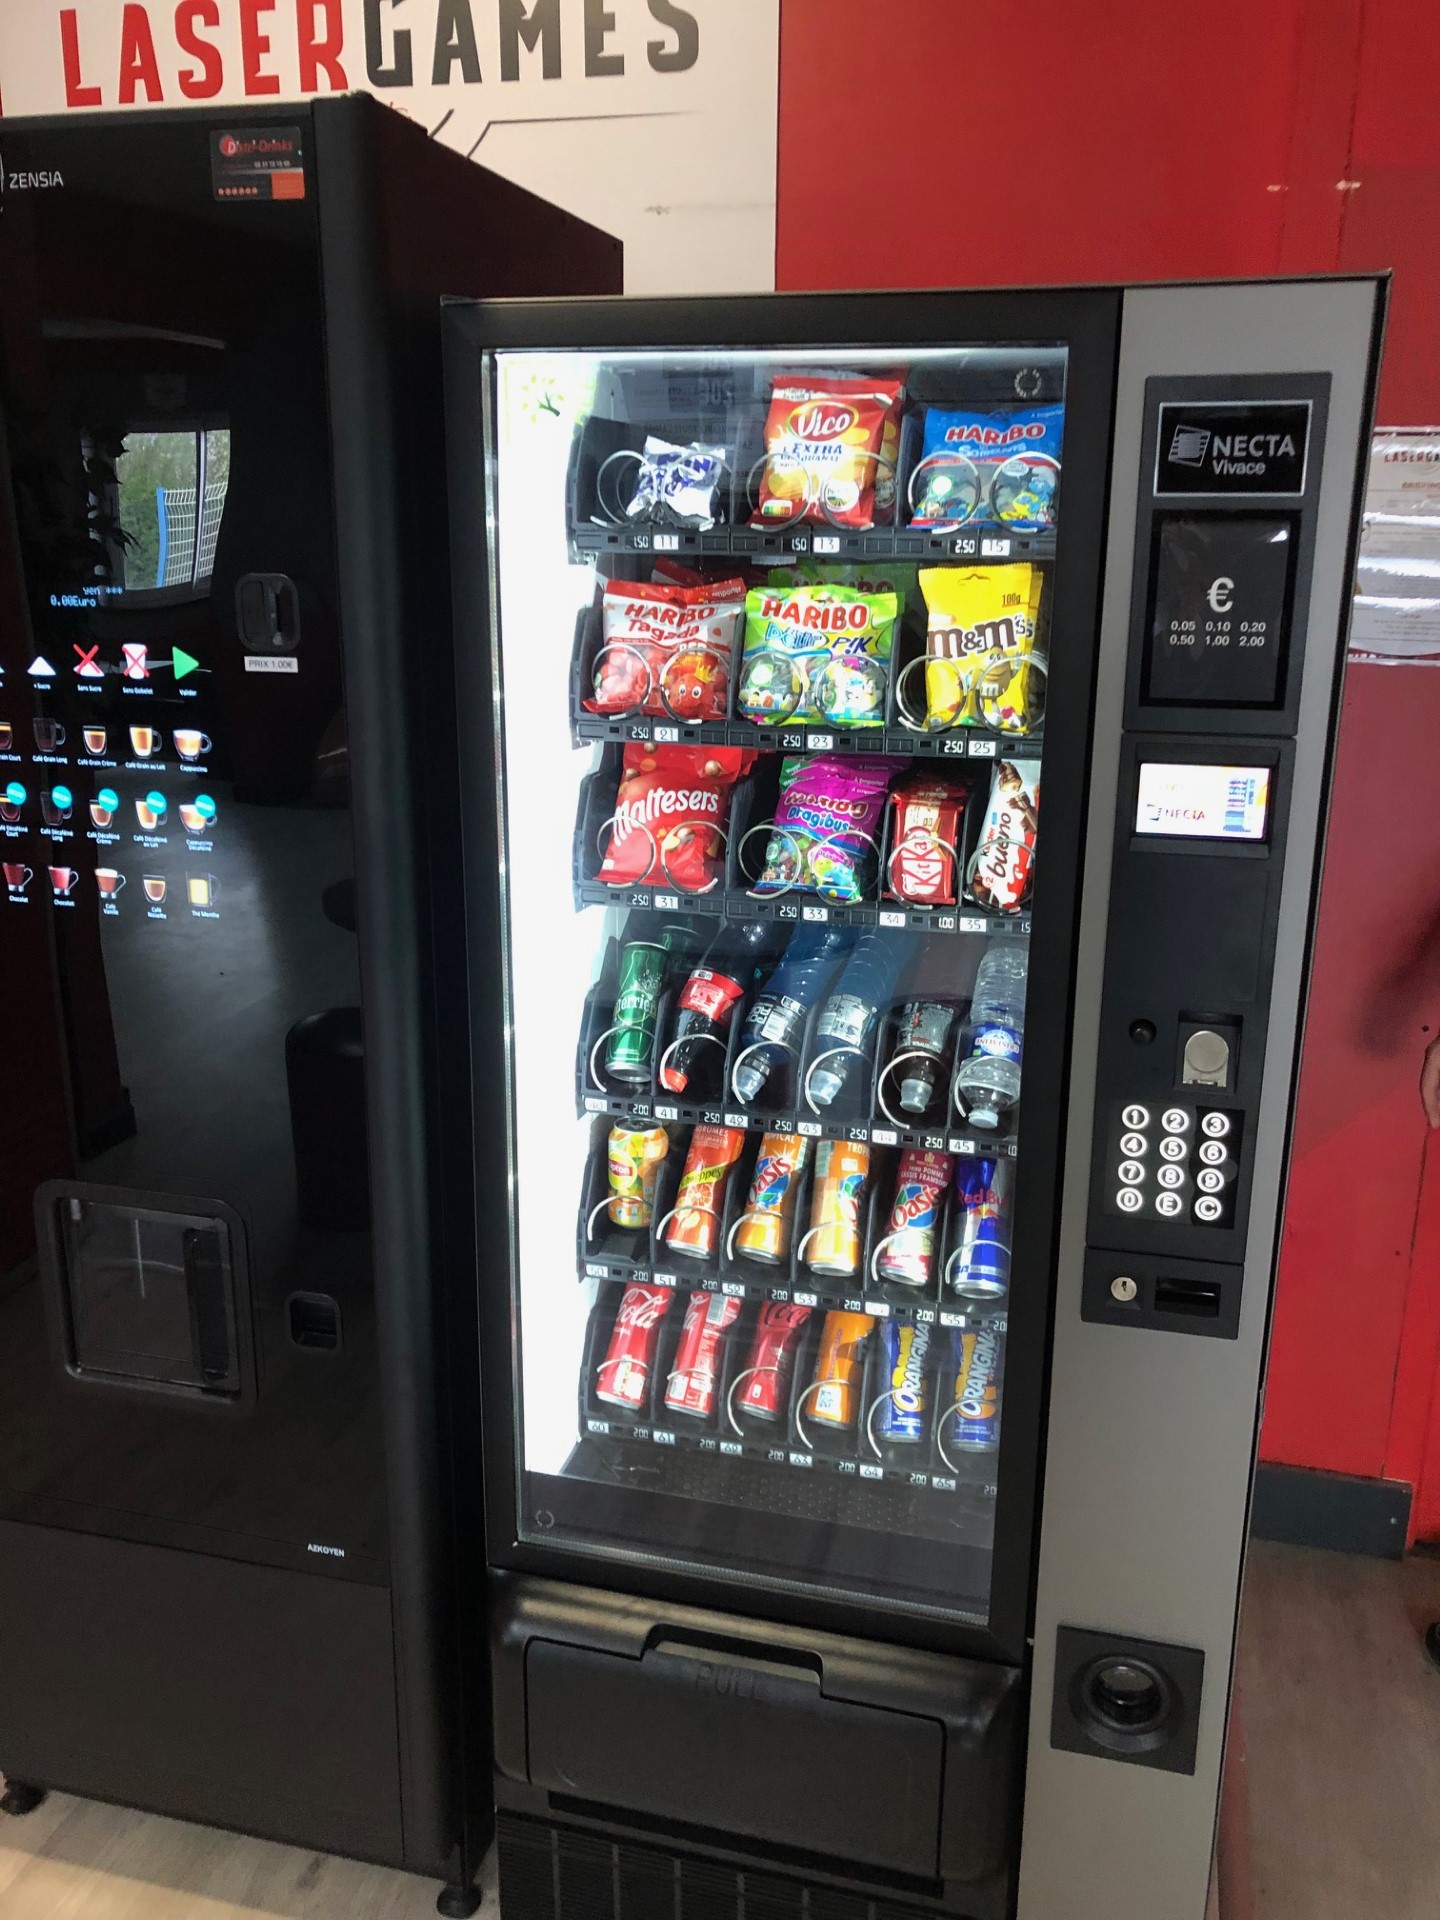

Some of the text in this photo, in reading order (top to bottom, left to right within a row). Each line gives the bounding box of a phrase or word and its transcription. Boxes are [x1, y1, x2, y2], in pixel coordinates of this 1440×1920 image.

[60, 0, 700, 107] LASERGAMES
[9, 171, 63, 188] ZENSIA
[798, 407, 851, 437] Vico
[945, 422, 1046, 445] HARIBO
[1212, 435, 1295, 457] NECTA
[1212, 460, 1266, 475] Vivace
[819, 540, 834, 550] 13
[1002, 593, 1021, 605] 100g
[1207, 577, 1234, 612] €
[624, 603, 716, 627] HARIBO
[762, 600, 867, 631] HARIBO
[628, 619, 700, 641] Tagada
[249, 660, 294, 669] PRIX 1.00€
[661, 729, 673, 740] 21
[813, 736, 828, 748] 23
[944, 741, 990, 753] 2.50 25
[613, 786, 719, 846] Maltesers
[787, 806, 850, 831] Dragibus
[986, 813, 1012, 879] bueno
[661, 897, 674, 907] 31
[809, 908, 824, 919] 33
[885, 914, 900, 924] 34
[967, 919, 981, 930] 35
[661, 1106, 673, 1117] 41
[729, 1116, 744, 1126] 42
[803, 1124, 818, 1134] 43
[954, 1142, 970, 1152] 45
[659, 1275, 672, 1285] 51
[727, 1283, 741, 1294] 52
[800, 1294, 813, 1304] 53
[896, 1322, 931, 1410] ORANGINA
[592, 1423, 605, 1433] 60
[658, 1432, 671, 1442] 61
[794, 1455, 809, 1464] 63
[864, 1467, 878, 1477] 64
[937, 1479, 951, 1489] 65
[307, 1543, 345, 1557] AZKOYEN
